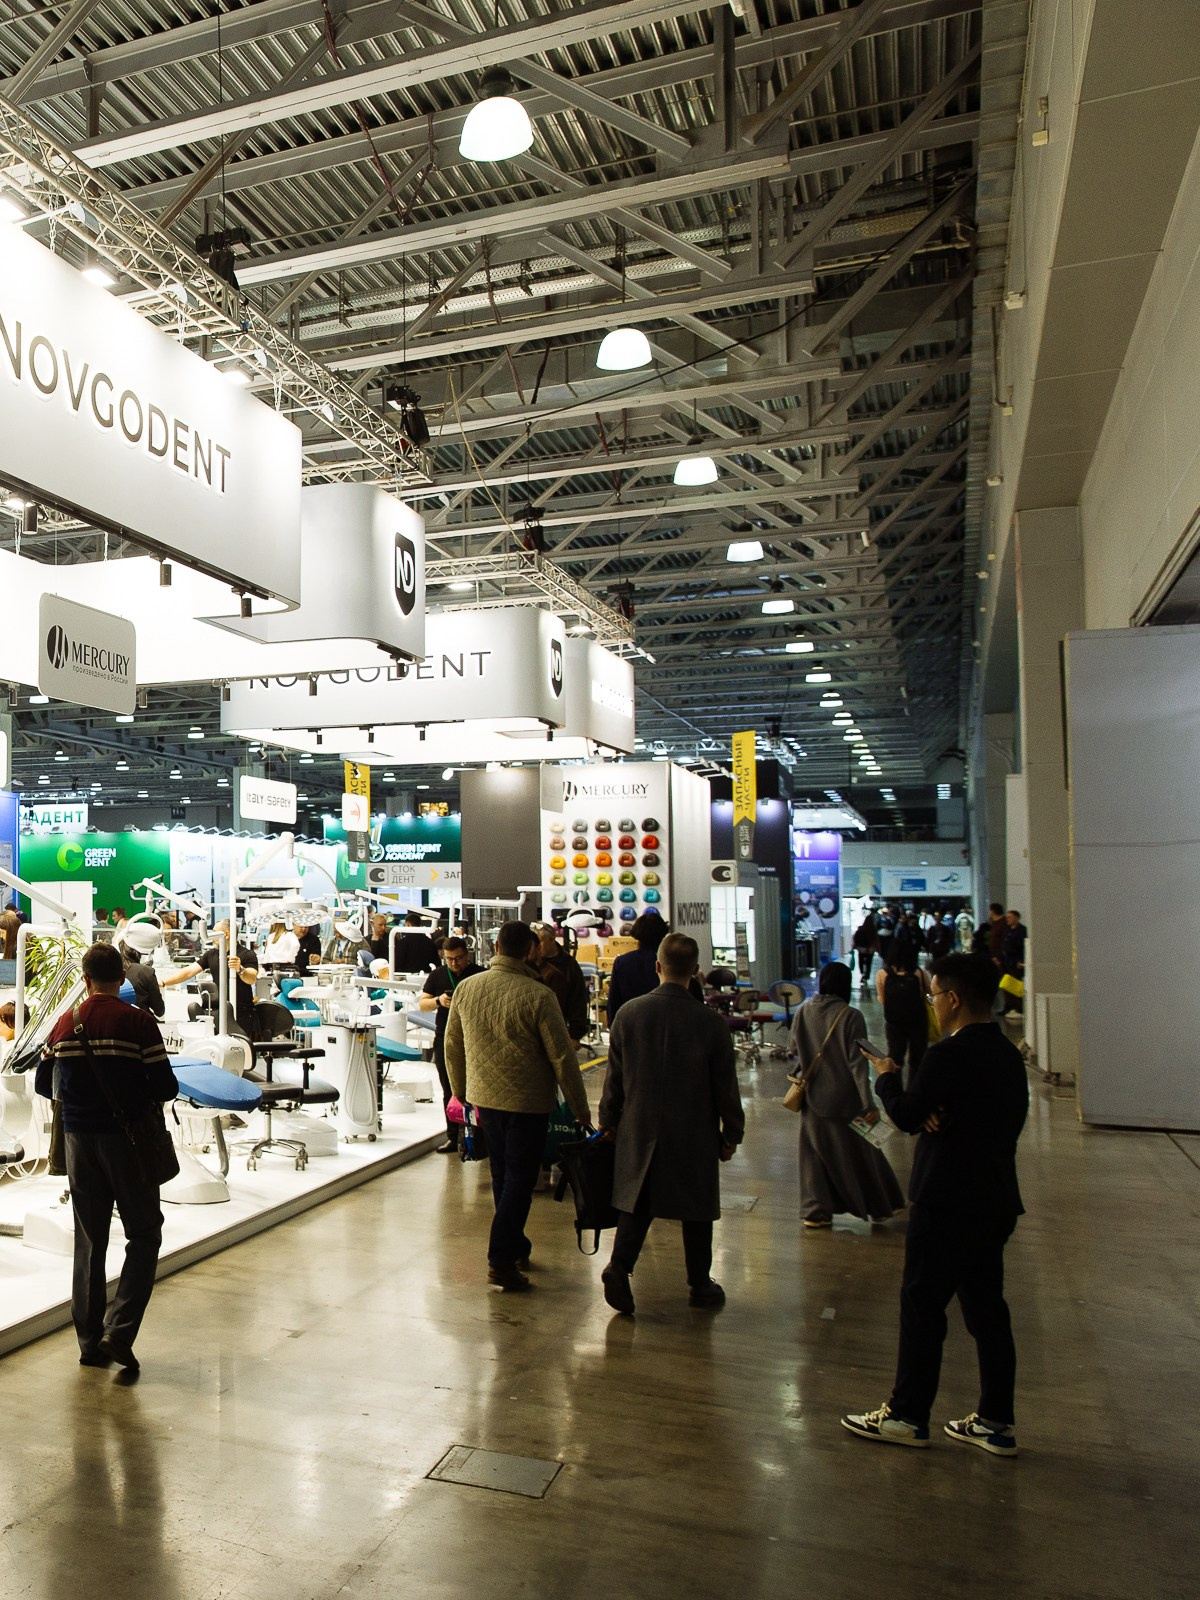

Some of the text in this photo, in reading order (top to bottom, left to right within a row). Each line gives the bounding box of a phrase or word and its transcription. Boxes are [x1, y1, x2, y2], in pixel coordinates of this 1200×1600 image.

[71, 641, 130, 676] MERCURY
[249, 651, 492, 689] GODENT
[581, 784, 650, 796] MERCURY
[85, 848, 116, 858] GREEN
[385, 844, 441, 853] GREEN DENT
[385, 852, 426, 860] ACADEMY
[85, 857, 110, 867] DENT
[391, 865, 415, 873] СТОК
[391, 875, 415, 884] ДЕНТ
[676, 902, 710, 926] NOVGODENT
